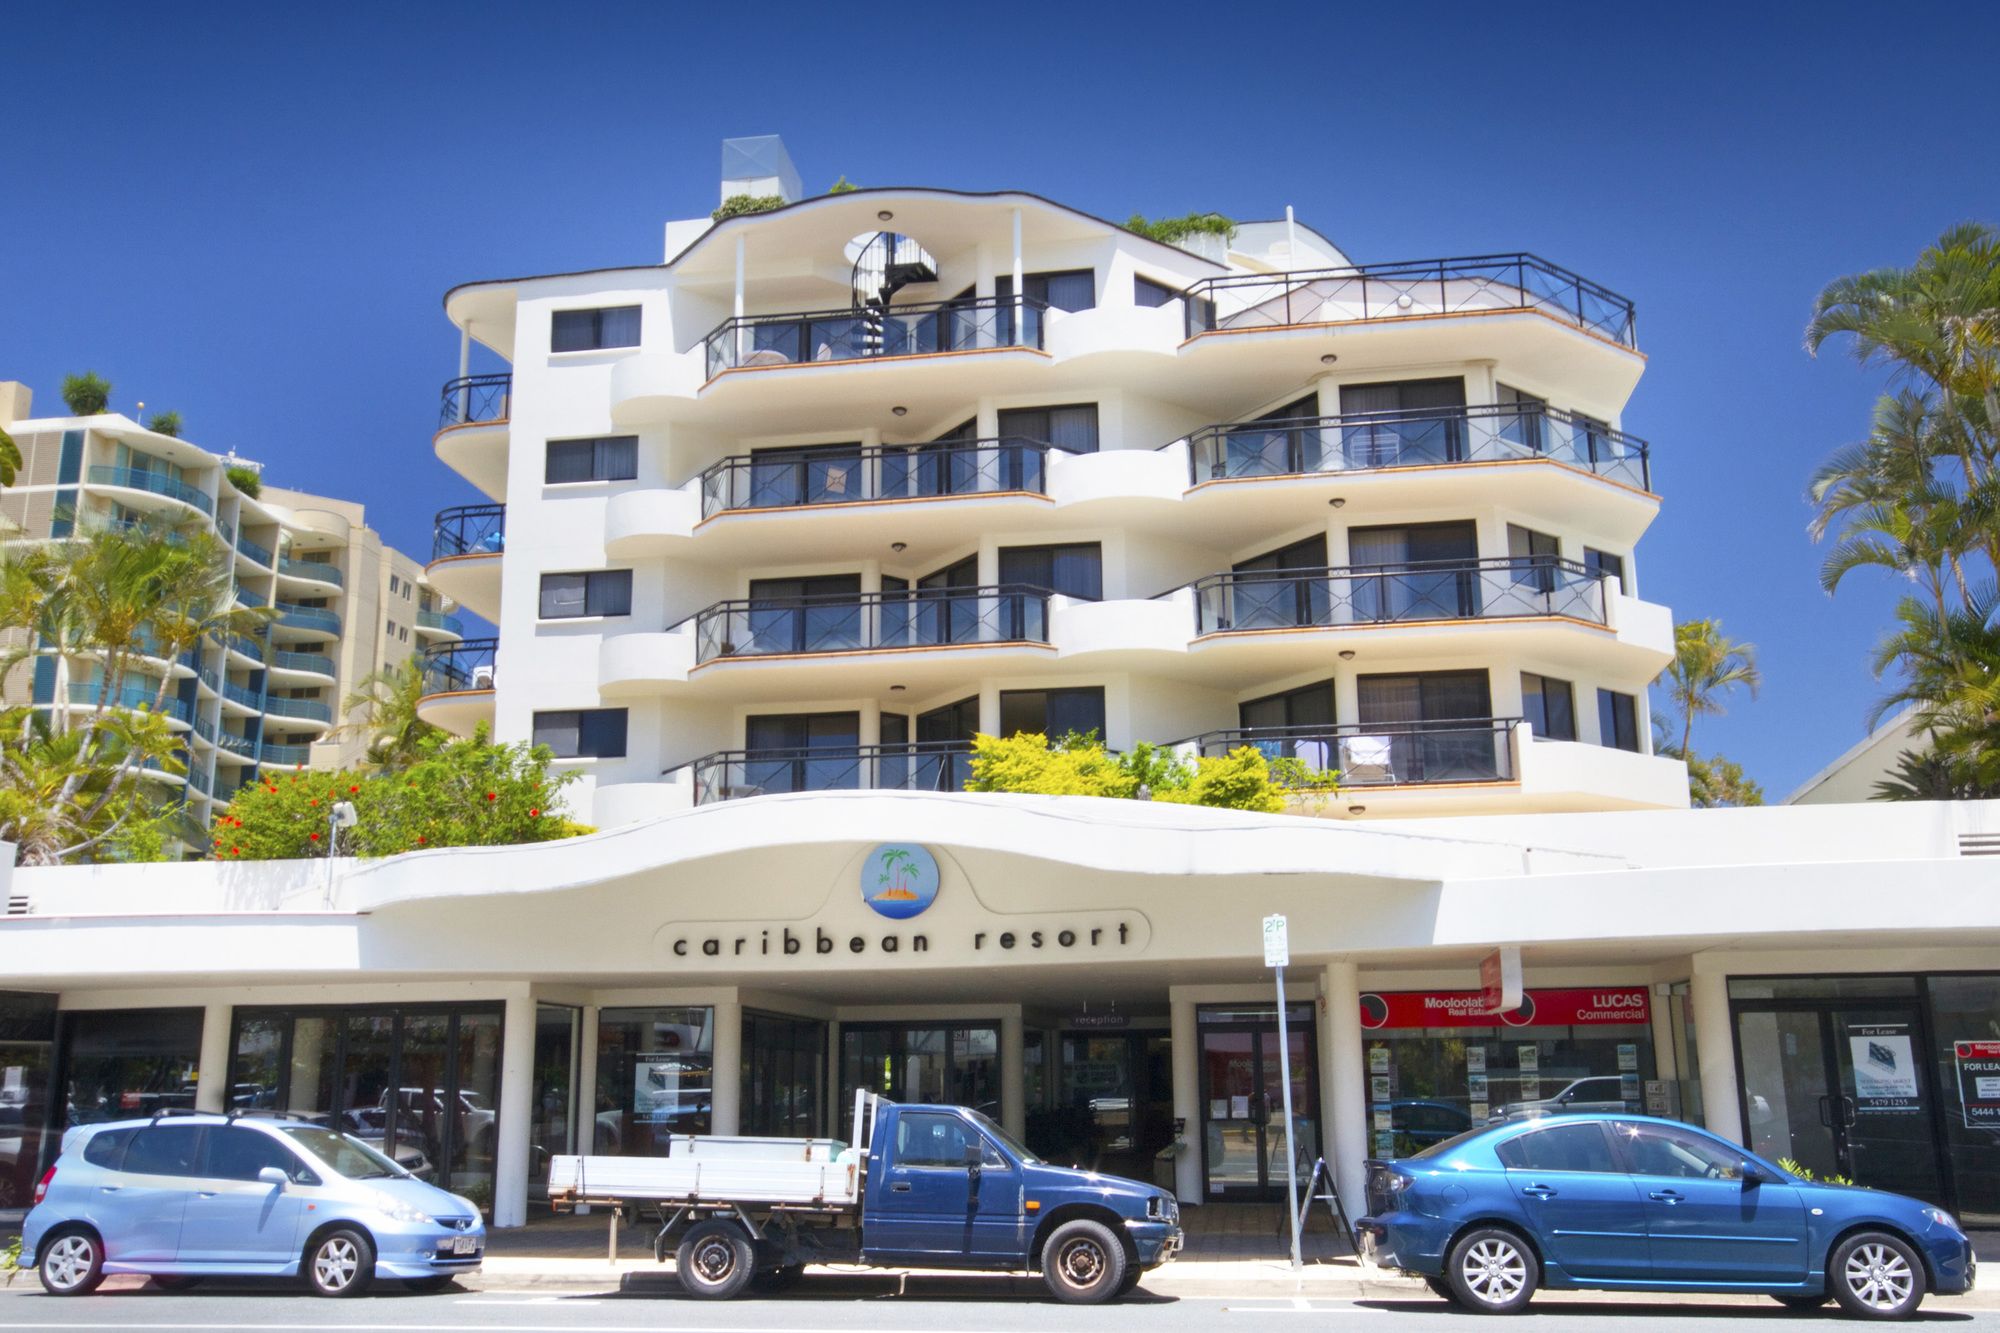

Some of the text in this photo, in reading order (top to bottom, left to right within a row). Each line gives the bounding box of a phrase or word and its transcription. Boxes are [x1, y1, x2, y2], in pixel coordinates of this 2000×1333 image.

[673, 922, 1129, 956] caribbean resort
[1425, 996, 1485, 1009] Mooloolab
[1593, 994, 1643, 1008] LUCAS
[1448, 1008, 1467, 1016] Real
[1577, 1009, 1645, 1020] Commercial
[1075, 1015, 1124, 1025] reception
[1876, 1027, 1897, 1035] Lease
[1964, 1062, 1982, 1071] FOR
[1972, 1107, 1993, 1116] 5444
